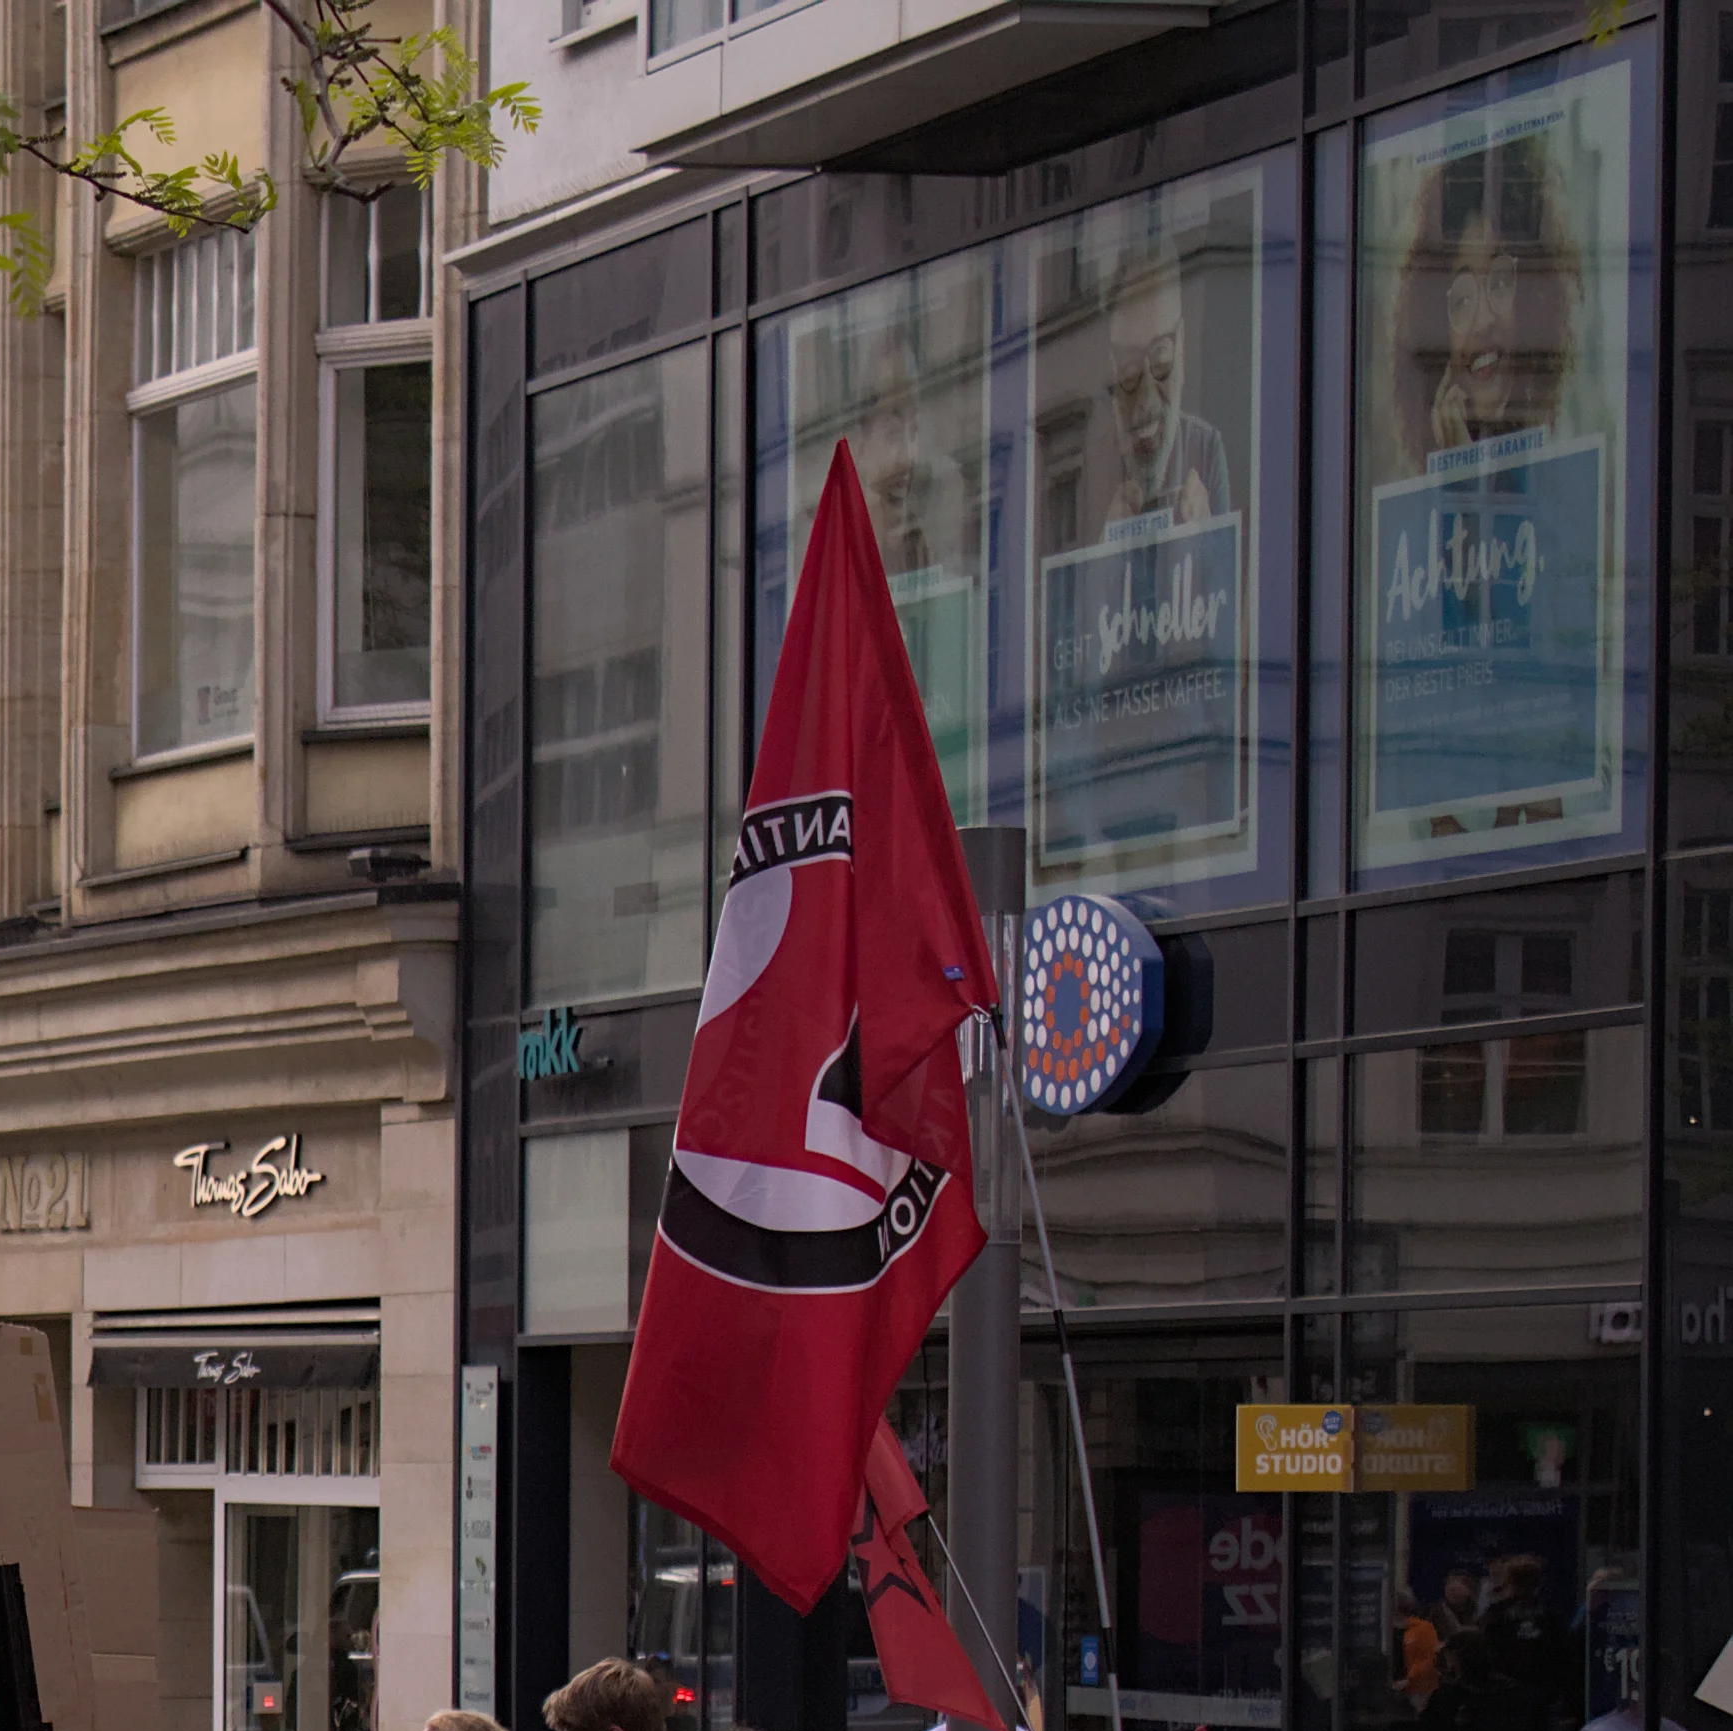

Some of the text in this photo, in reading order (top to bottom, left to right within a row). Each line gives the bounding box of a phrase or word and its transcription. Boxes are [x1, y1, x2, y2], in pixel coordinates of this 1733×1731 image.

[1386, 507, 1545, 624] Achtung.
[1098, 552, 1228, 675] schneller
[1114, 679, 1161, 719] TASSE
[174, 1133, 322, 1217] Thomas Sabo
[1255, 1453, 1343, 1475] STUDIO
[1280, 1423, 1338, 1449] HÖR-
